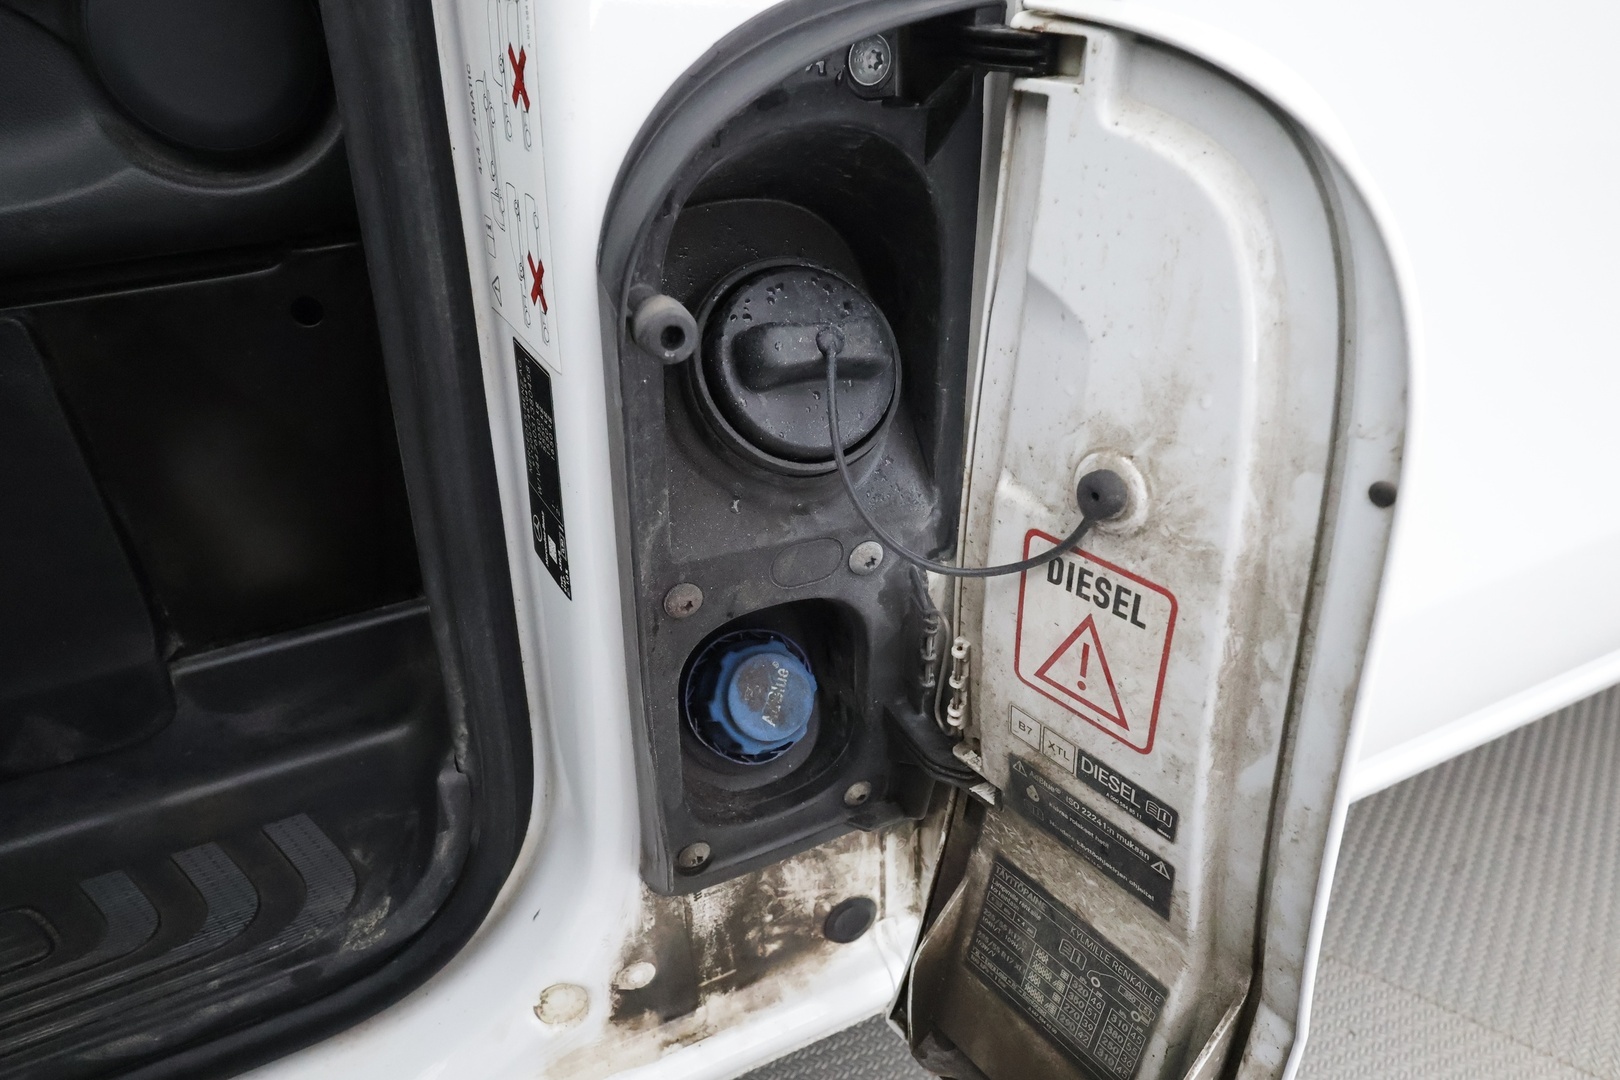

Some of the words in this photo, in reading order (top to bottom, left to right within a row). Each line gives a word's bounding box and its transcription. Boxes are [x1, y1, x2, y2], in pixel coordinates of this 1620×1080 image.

[466, 64, 477, 126] 4MATIC
[1047, 556, 1146, 630] DIESEL
[1018, 721, 1033, 735] B7
[1048, 740, 1070, 761] XTL
[1080, 756, 1141, 808] DIESEL
[1066, 796, 1080, 810] ISO
[1116, 832, 1150, 860] mukaan
[994, 865, 1047, 912] TÄYTTÖPAINE
[1070, 926, 1111, 964] KYLMILLE
[1112, 960, 1160, 1005] RENKAILLE
[1072, 980, 1088, 997] 320
[1091, 997, 1102, 1009] 46
[1064, 1004, 1080, 1020] 270
[1086, 1008, 1097, 1020] 51
[1060, 1014, 1076, 1031] 290
[1082, 1020, 1093, 1031] 39
[1111, 1014, 1128, 1032] 310
[1078, 1032, 1089, 1043] 42
[1107, 1026, 1124, 1044] 380
[1131, 1033, 1142, 1045] 45
[1101, 1037, 1119, 1055] 250
[1126, 1043, 1137, 1056] 55
[1097, 1048, 1114, 1066] 310
[1121, 1054, 1132, 1068] 36
[1116, 1067, 1128, 1079] 45
